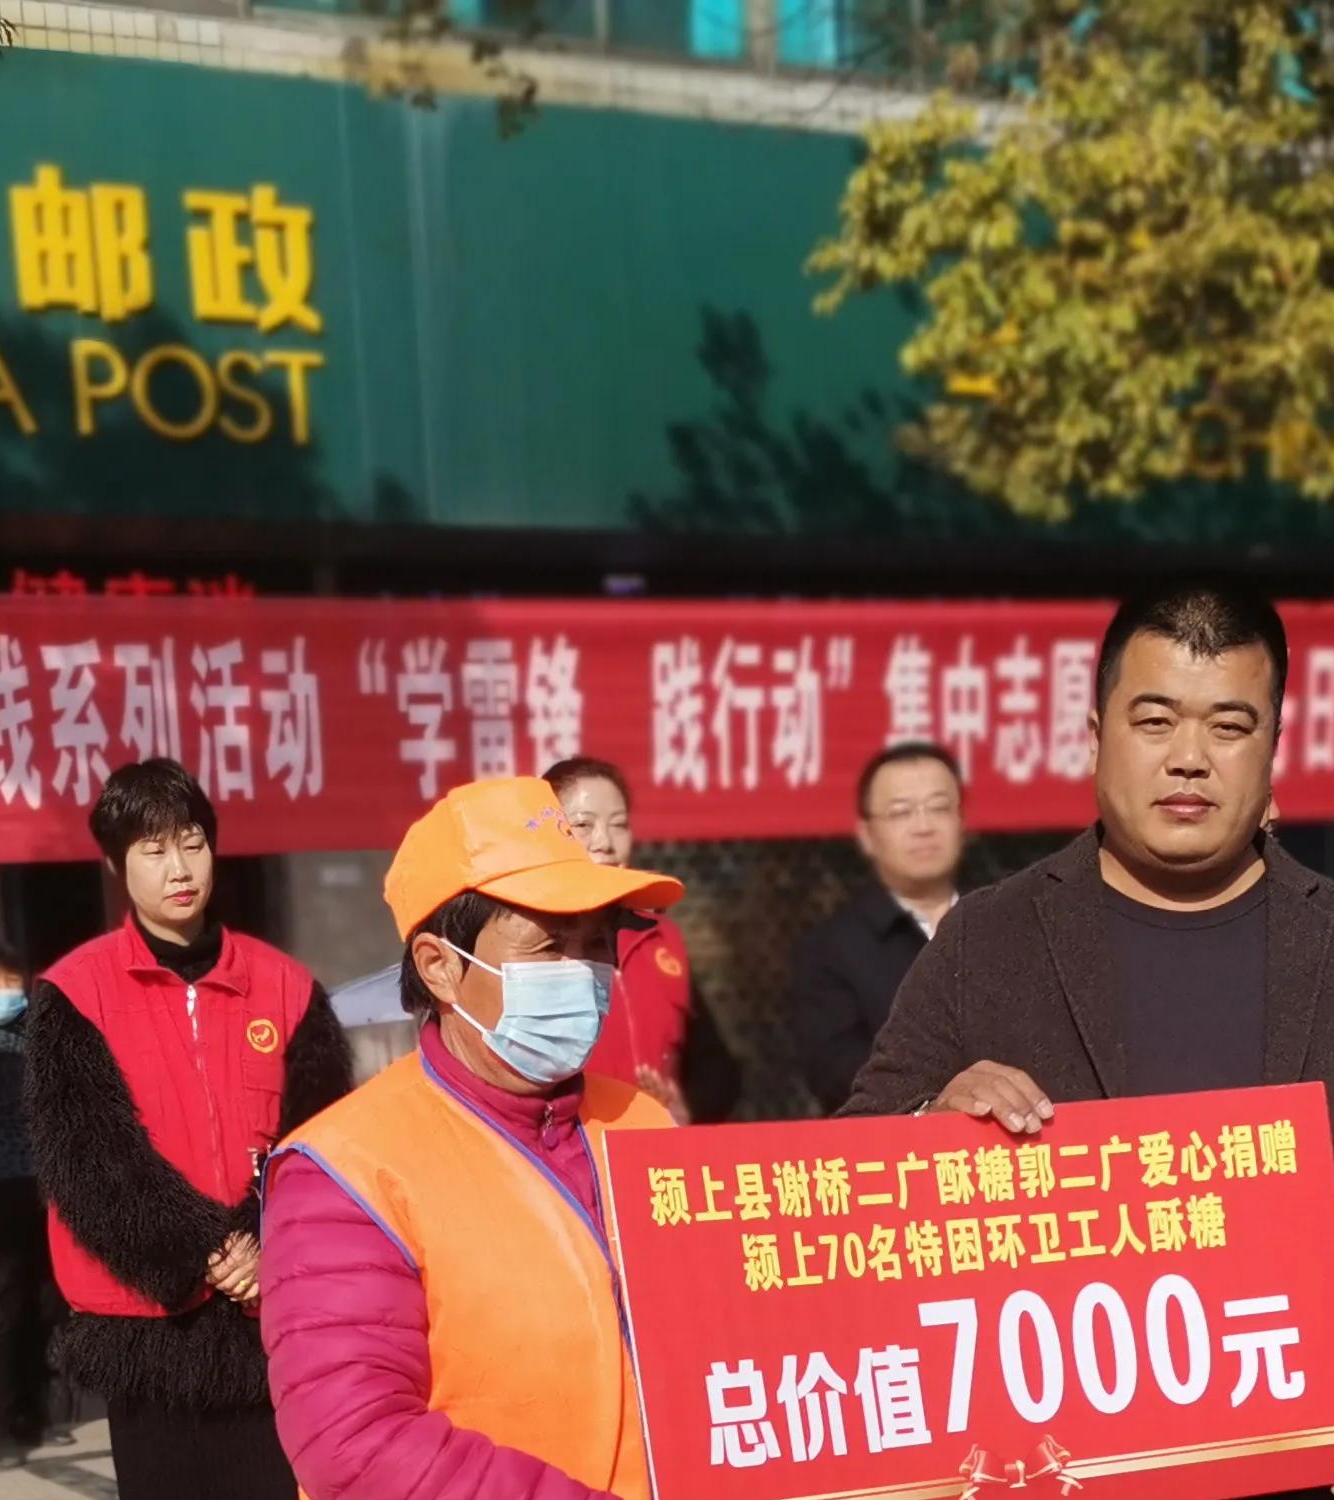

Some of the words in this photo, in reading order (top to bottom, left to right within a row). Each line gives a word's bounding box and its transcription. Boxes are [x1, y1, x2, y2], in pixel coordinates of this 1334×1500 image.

[72, 338, 324, 445] POST
[648, 1119, 1298, 1227] 颍上县谢桥二广酥糖郭二广爱心捐赠
[741, 1191, 1227, 1292] 颍上70名特困环卫工人酥糖
[704, 1273, 1307, 1469] 总价值7000元
